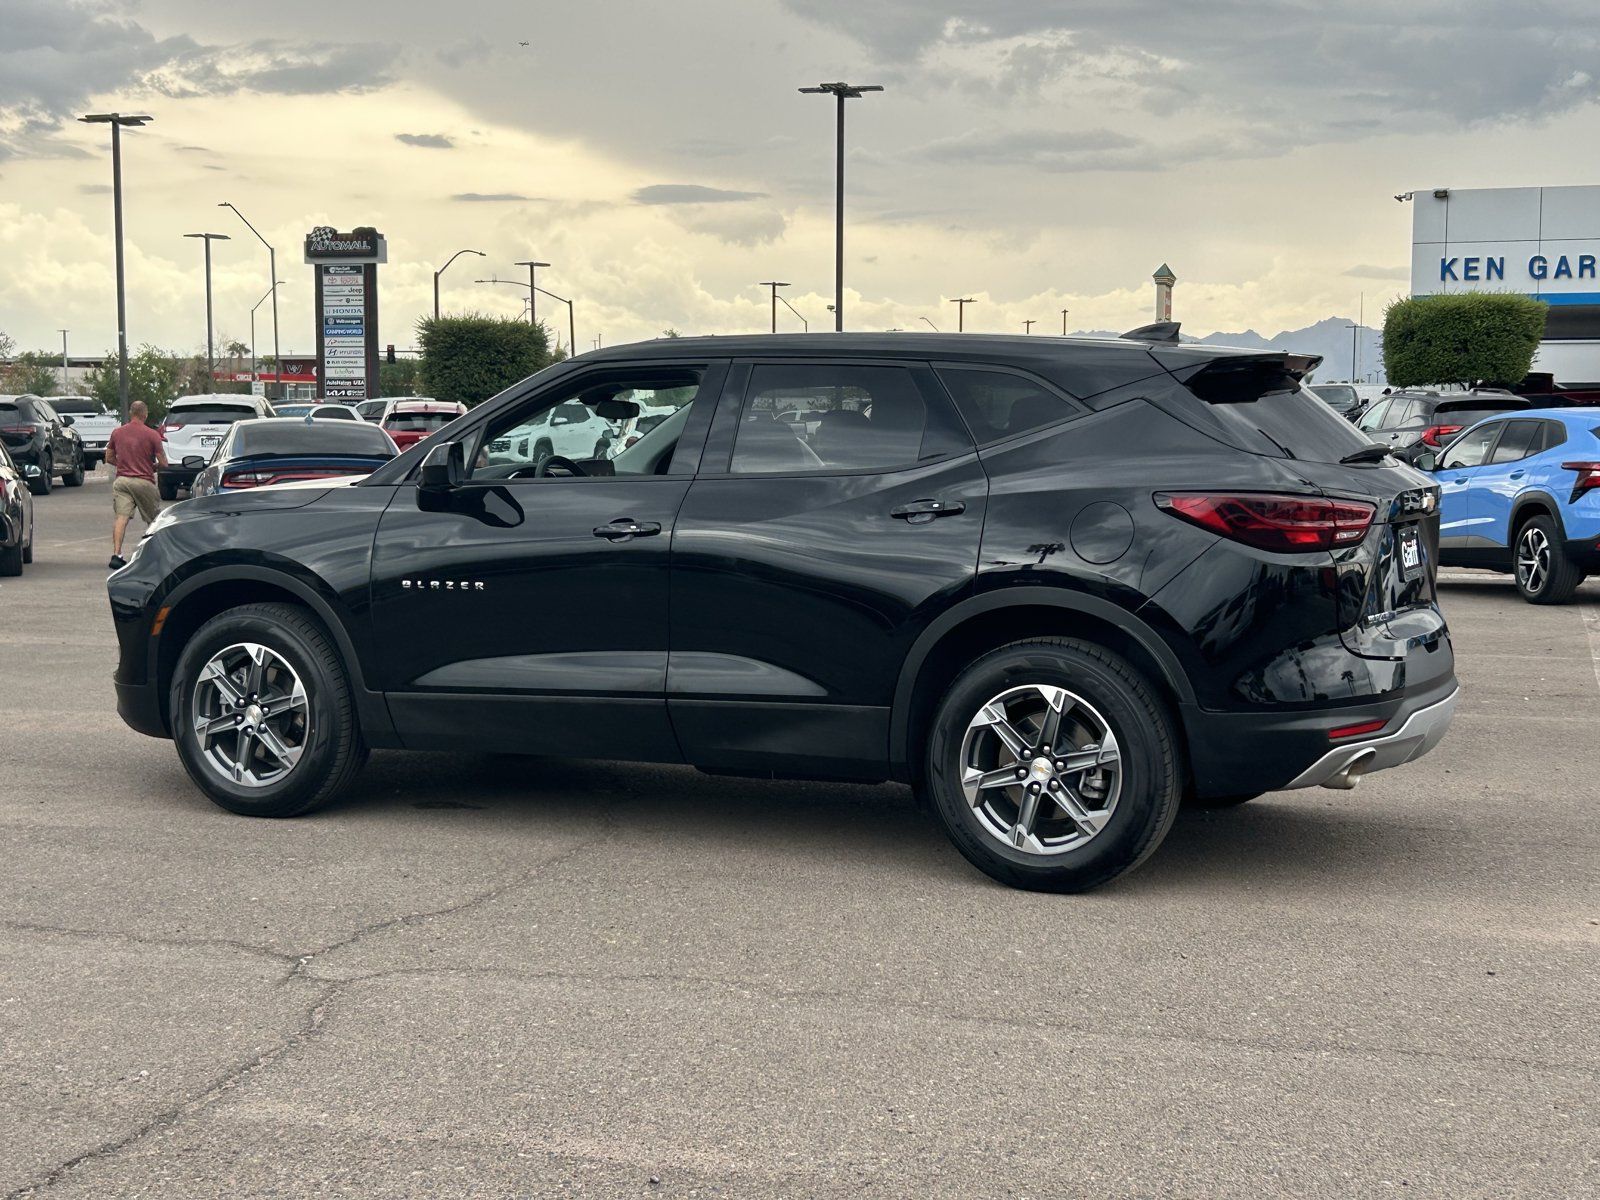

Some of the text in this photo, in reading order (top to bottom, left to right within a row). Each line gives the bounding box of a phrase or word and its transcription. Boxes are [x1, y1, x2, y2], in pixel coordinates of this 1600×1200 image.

[311, 240, 369, 250] AUTOMALL
[1440, 254, 1596, 282] KEN GAR
[401, 579, 484, 590] BLAZER
